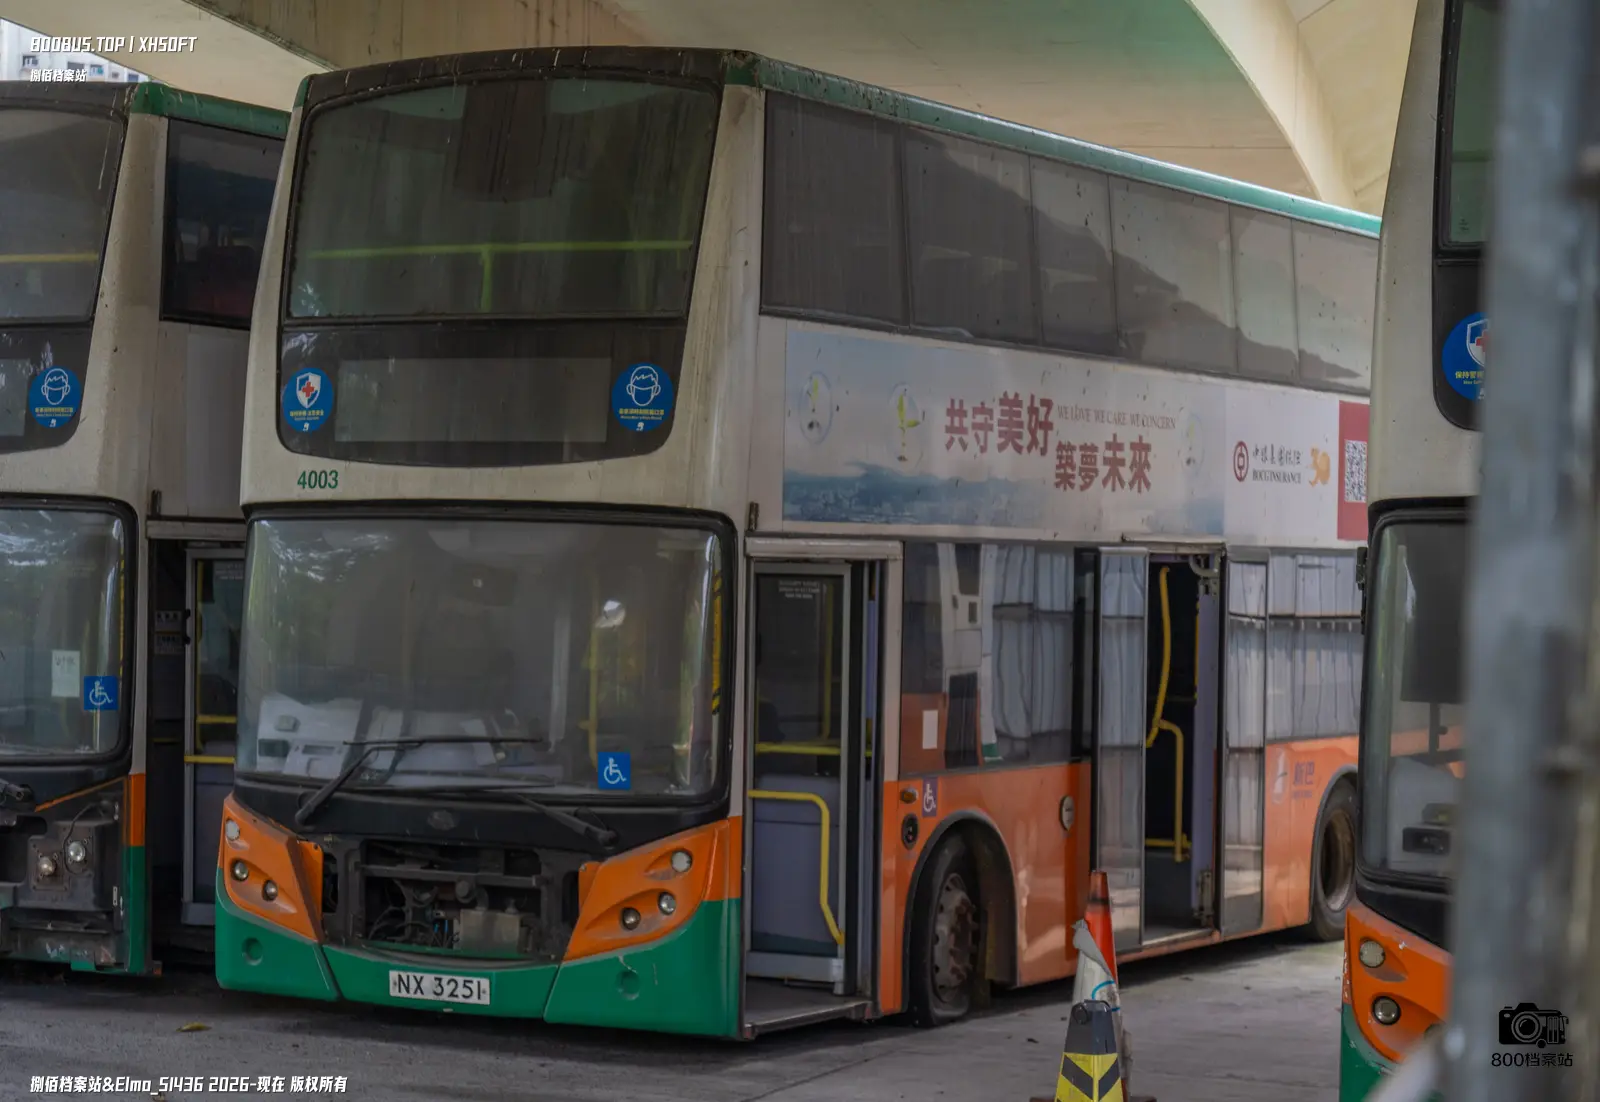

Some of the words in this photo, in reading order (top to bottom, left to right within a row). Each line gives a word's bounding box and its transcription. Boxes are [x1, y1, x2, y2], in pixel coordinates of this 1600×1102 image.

[945, 390, 1054, 457] 共守美好
[297, 469, 339, 490] 4003
[1053, 432, 1152, 493] 築夢未來
[398, 973, 424, 996] NX
[433, 976, 482, 1000] 3251
